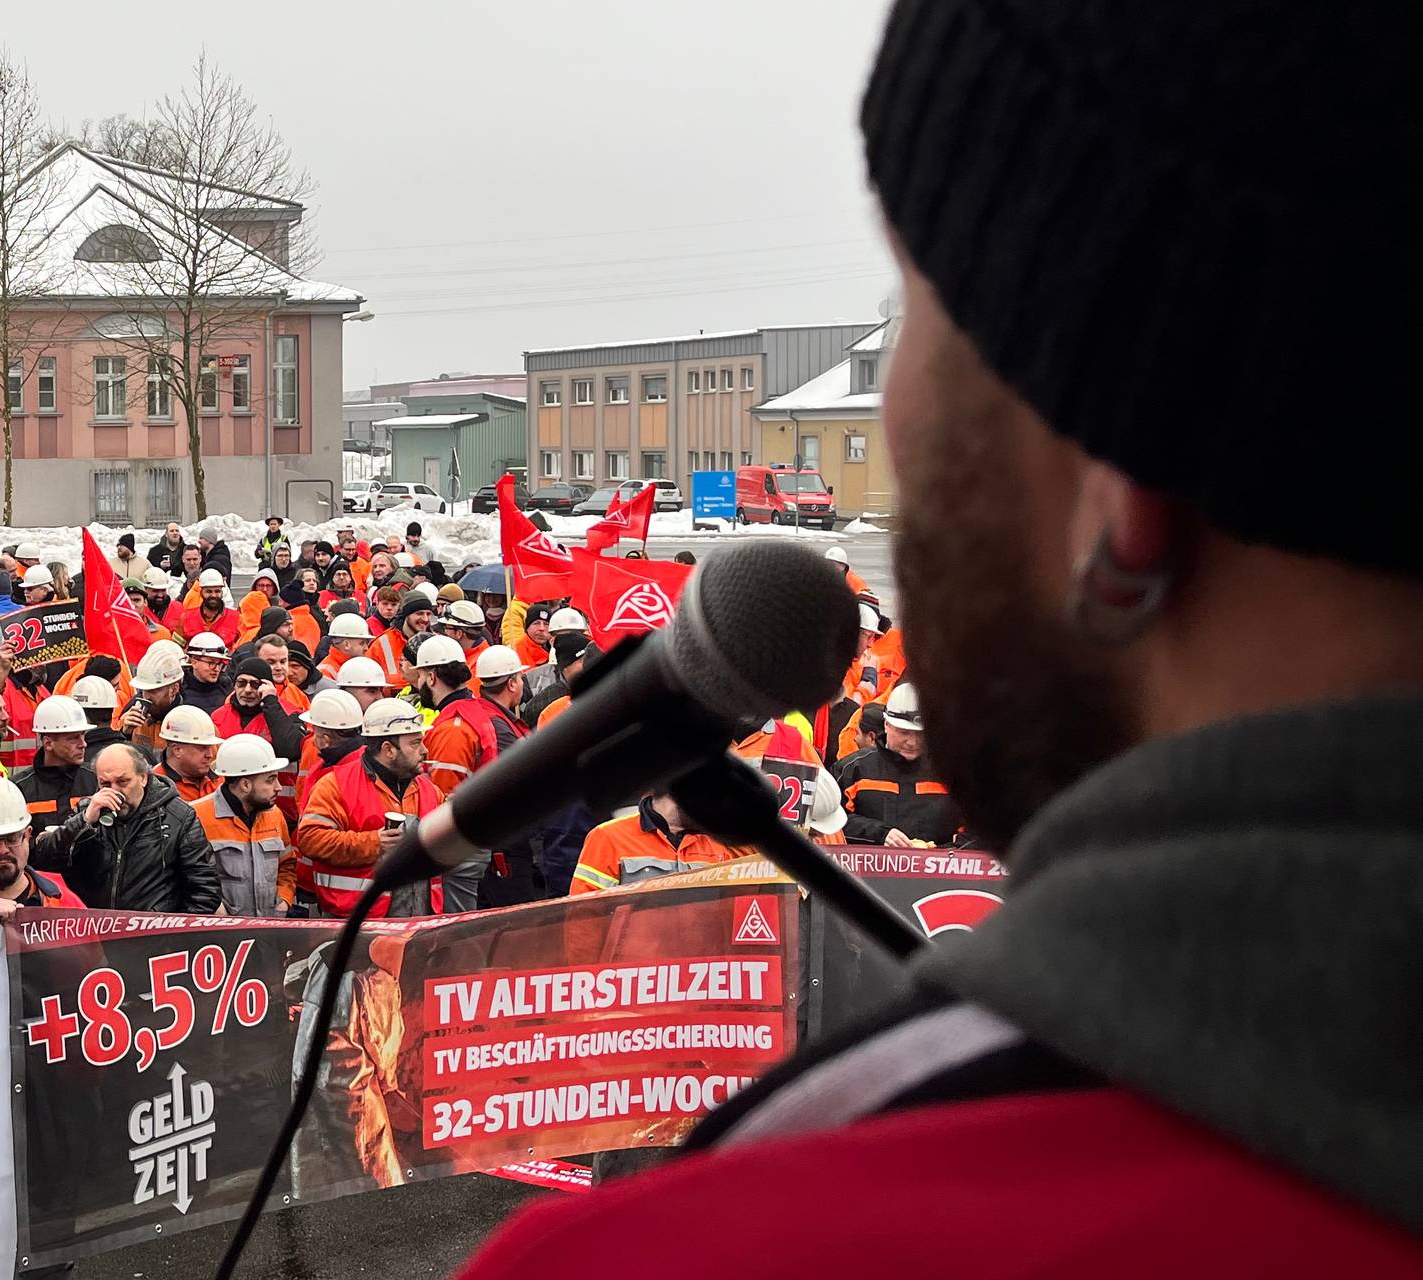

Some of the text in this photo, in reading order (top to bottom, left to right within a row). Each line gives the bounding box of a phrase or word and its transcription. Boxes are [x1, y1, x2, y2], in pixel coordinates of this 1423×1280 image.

[5, 617, 46, 655] 32
[45, 622, 71, 634] WOCHE
[21, 916, 126, 944] TARIFRUNDE
[27, 938, 269, 1074] +8,5%
[434, 961, 769, 1024] TV ALTERSTEILZEIT
[433, 1023, 773, 1075] TV BESCHÄFTIGUNGSSICHERUNG
[128, 1066, 215, 1144] GELD
[133, 1136, 213, 1210] ZEIT
